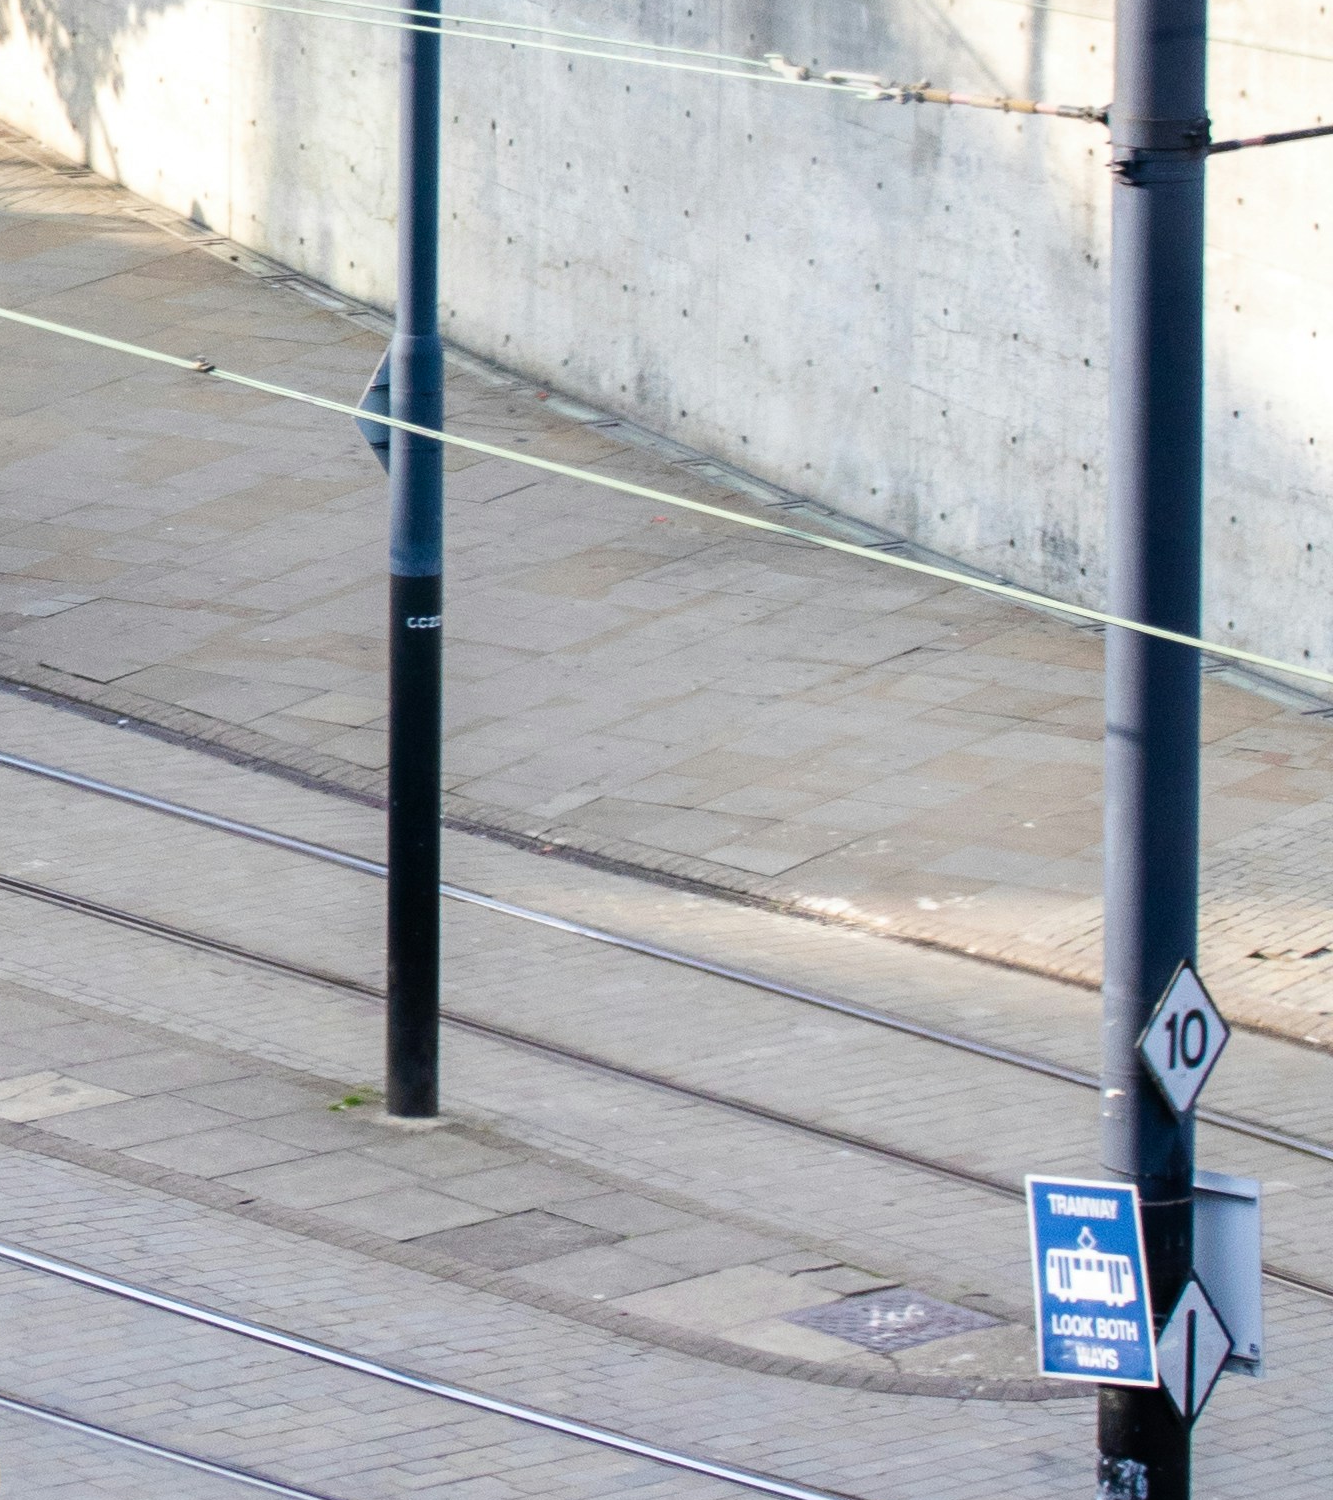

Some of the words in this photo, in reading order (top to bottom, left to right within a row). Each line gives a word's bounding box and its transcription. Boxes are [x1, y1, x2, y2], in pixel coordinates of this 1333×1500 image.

[1165, 1008, 1208, 1070] 10
[1046, 1192, 1118, 1221] TRAMWAY
[1051, 1313, 1094, 1338] LOOK
[1095, 1316, 1138, 1342] BOTH
[1074, 1345, 1120, 1371] WAYS
